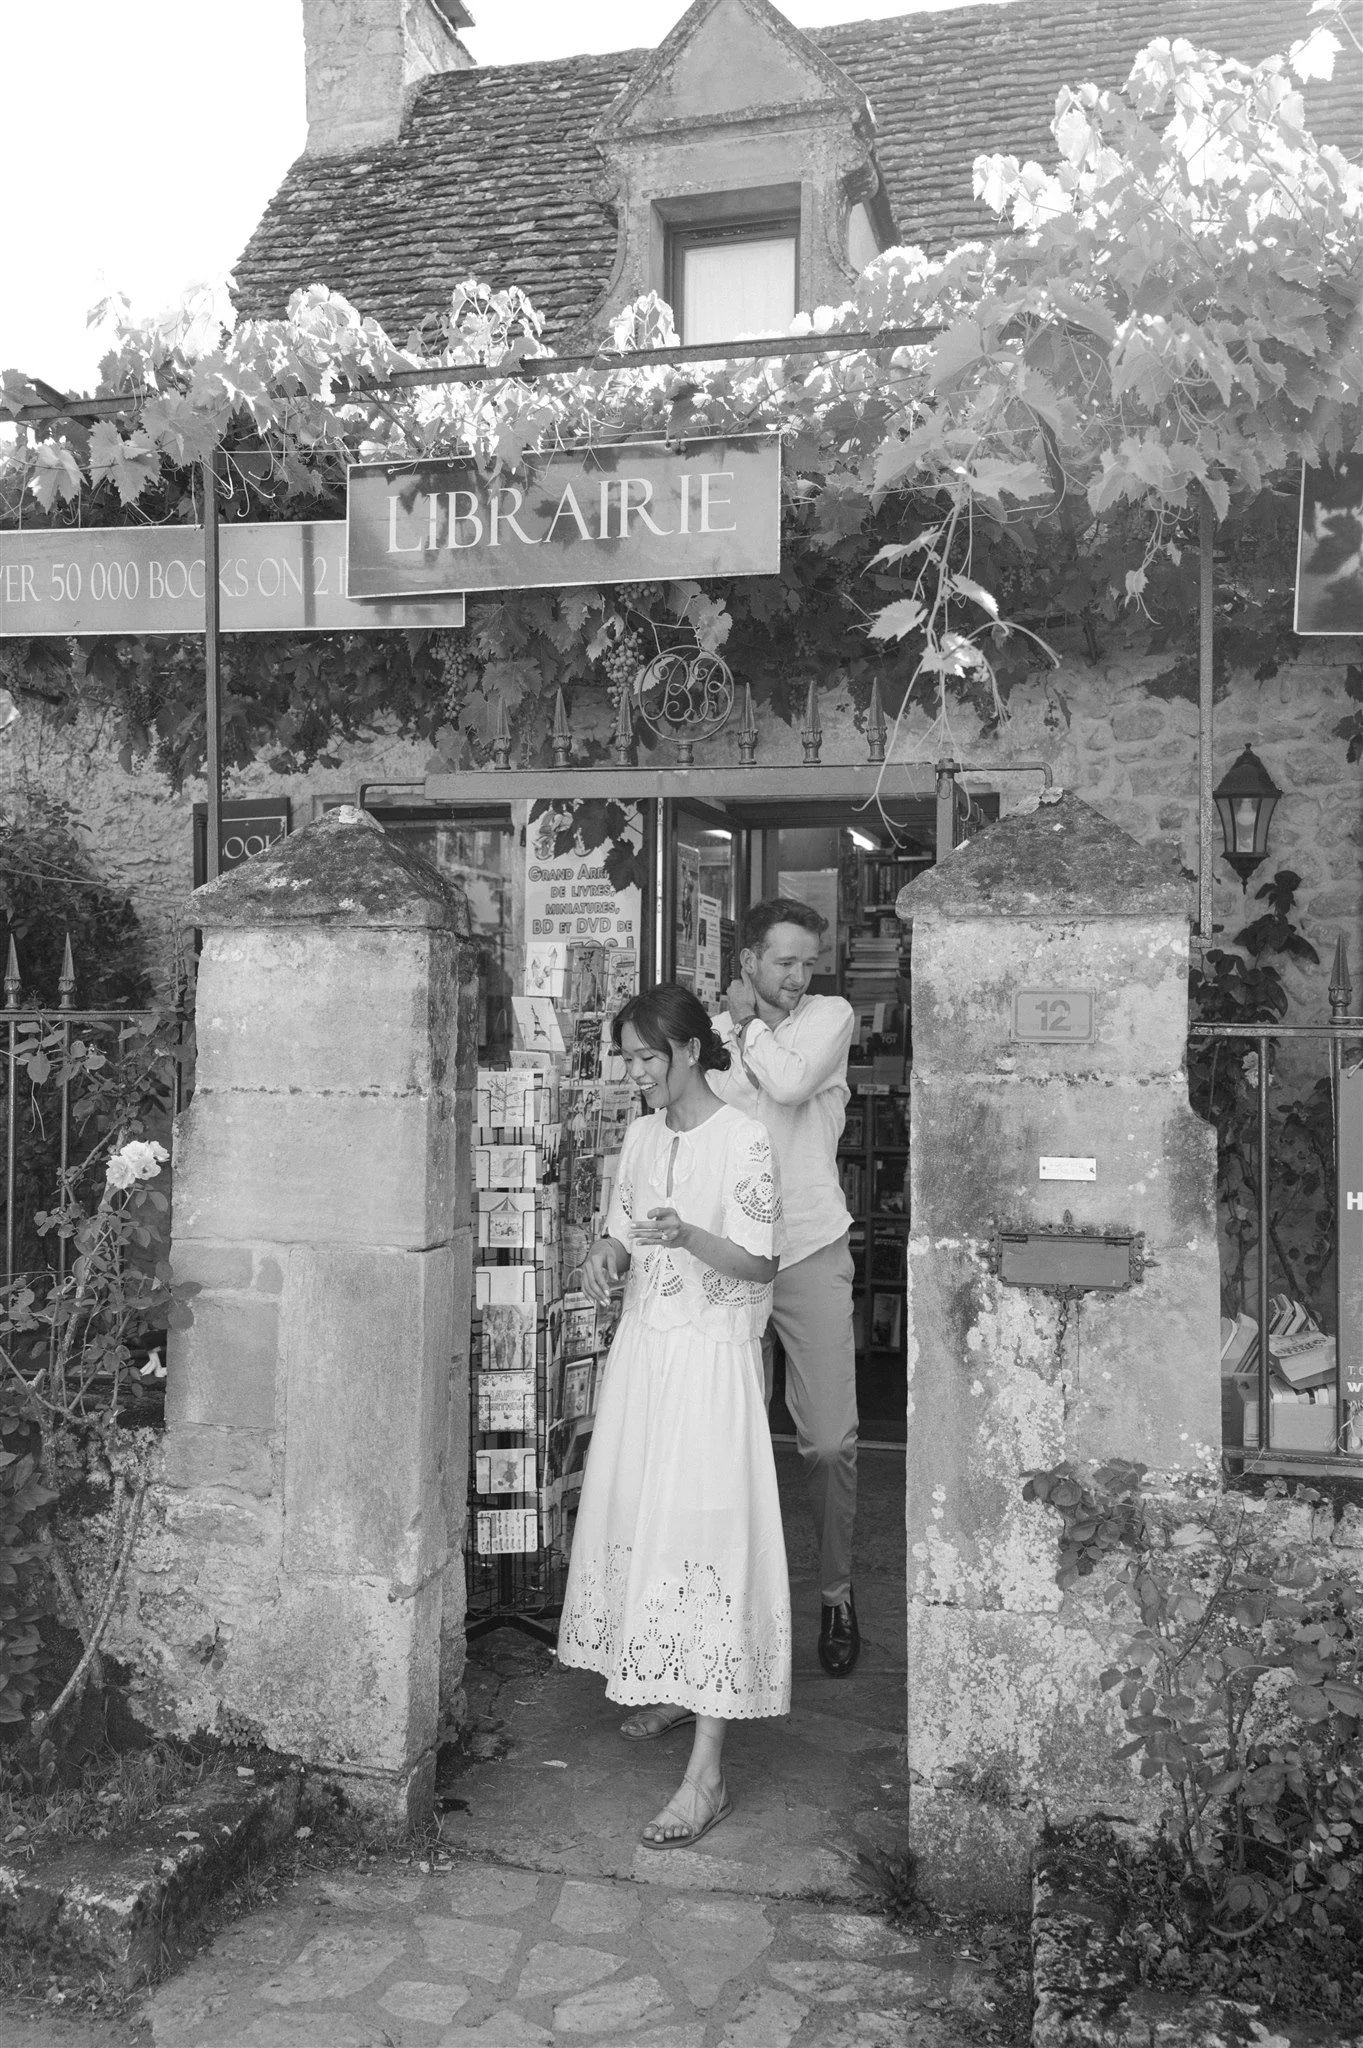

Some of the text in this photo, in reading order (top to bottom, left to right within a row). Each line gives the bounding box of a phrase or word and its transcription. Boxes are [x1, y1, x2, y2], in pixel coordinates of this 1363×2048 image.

[386, 471, 737, 553] LIBRAIRIE
[0, 565, 41, 602] ER
[50, 562, 82, 601] 50
[91, 561, 139, 600] 000
[150, 559, 249, 598] BOOKS
[257, 557, 304, 597] ON
[312, 556, 329, 595] 2
[528, 865, 574, 882] GRAND
[551, 884, 616, 898] DE LIVRES,
[545, 902, 621, 915] MINIATURES,
[532, 917, 633, 935] BD ET DVD DE
[1035, 999, 1072, 1032] 12
